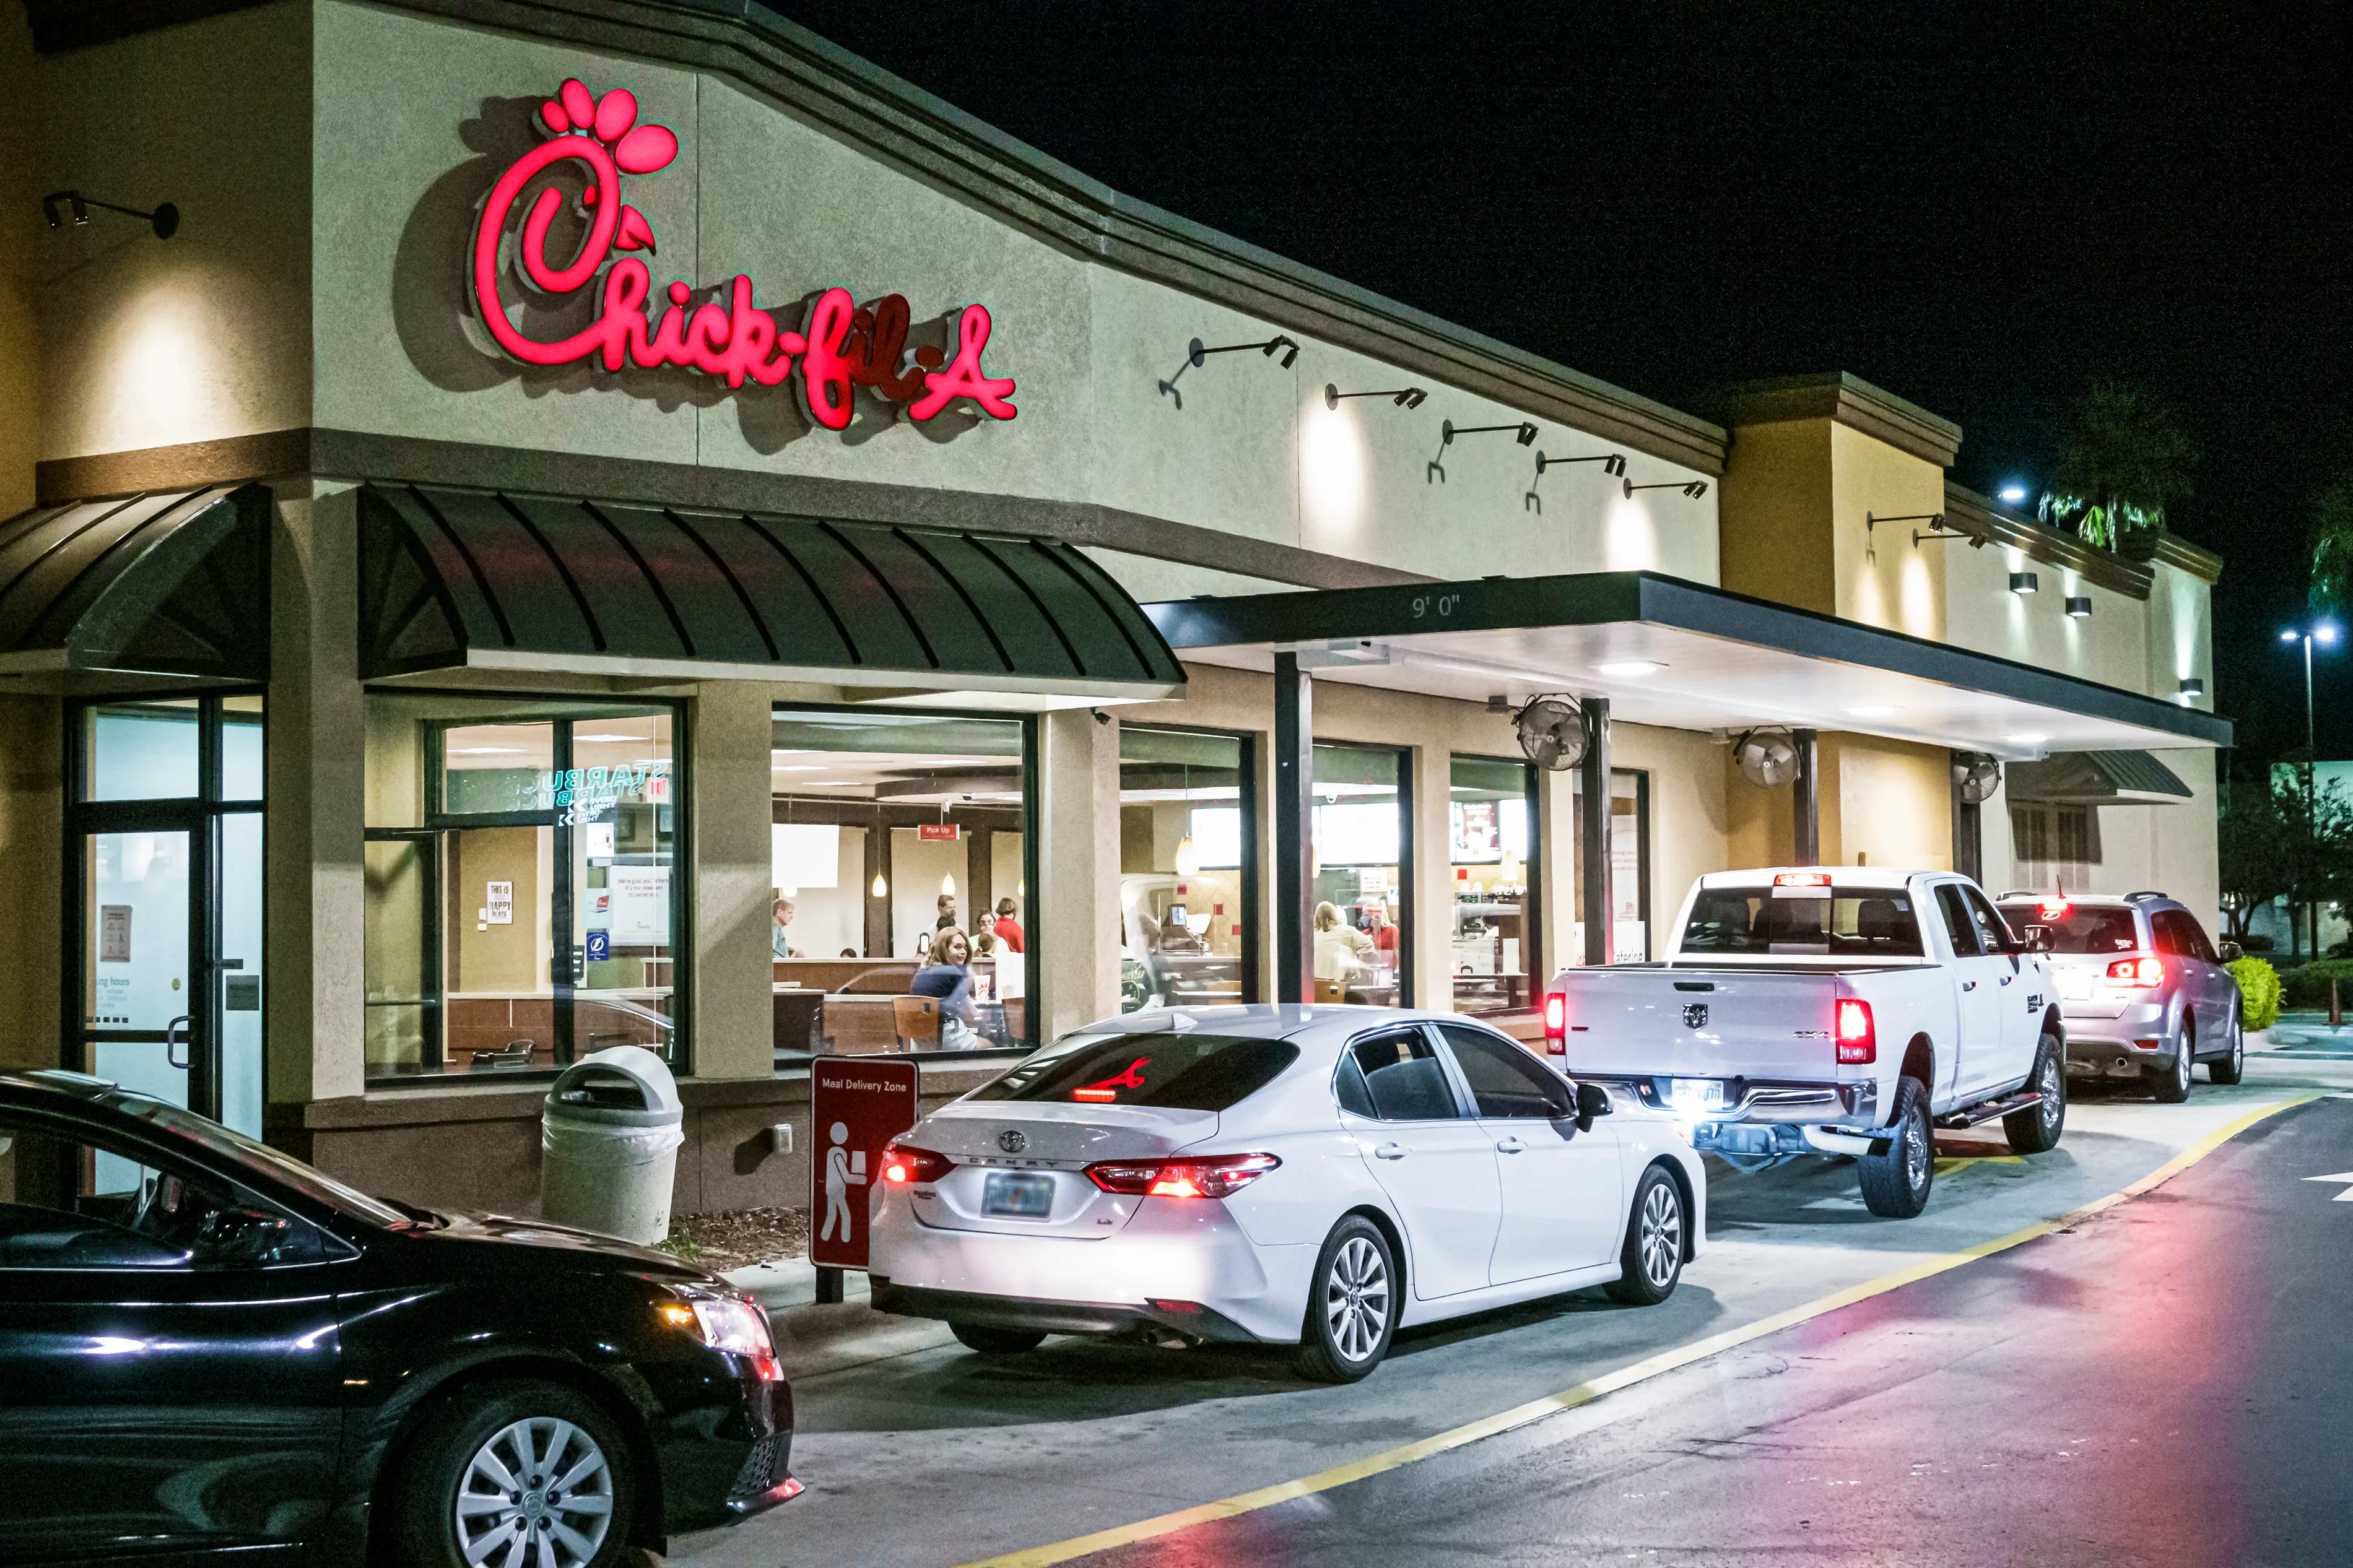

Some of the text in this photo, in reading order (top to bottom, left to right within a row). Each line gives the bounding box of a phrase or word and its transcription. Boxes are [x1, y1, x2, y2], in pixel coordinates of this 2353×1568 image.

[474, 77, 1019, 431] Chick-fil-A
[1412, 594, 1460, 618] 9' 0"
[491, 885, 509, 894] THIS IS
[1613, 948, 1643, 964] atering
[110, 976, 130, 986] hours
[822, 1078, 907, 1093] Meal Delivery Zone
[970, 1157, 1059, 1167] CAMRY
